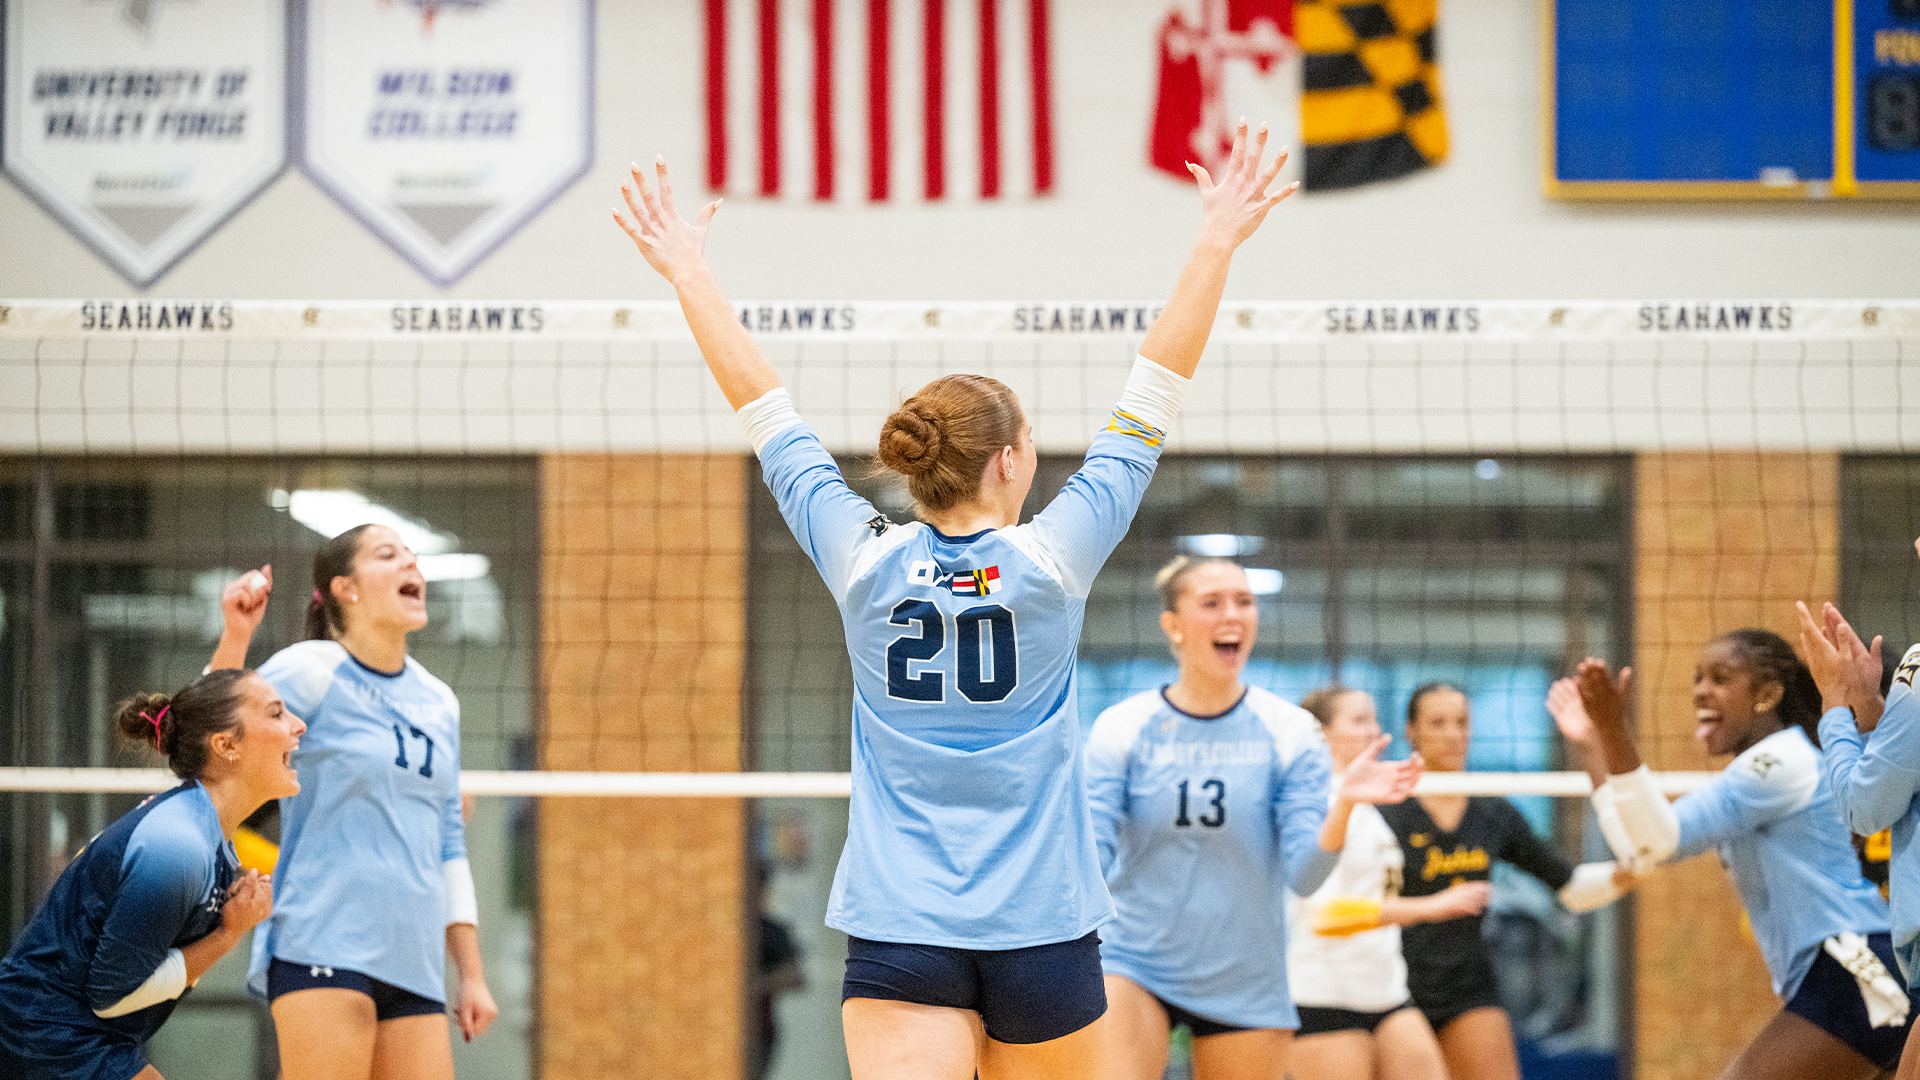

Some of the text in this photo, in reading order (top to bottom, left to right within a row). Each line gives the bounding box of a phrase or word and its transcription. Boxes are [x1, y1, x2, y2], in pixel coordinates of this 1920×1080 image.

[80, 302, 235, 331] SEAHAWKS
[391, 305, 544, 332] SEAHAWKS
[739, 306, 856, 332] AHAWKS
[1325, 306, 1480, 332] SEAHAWKS
[1638, 304, 1793, 331] SEAHAWKS
[885, 596, 1020, 704] 20
[392, 723, 434, 779] 17
[1175, 778, 1226, 829] 13
